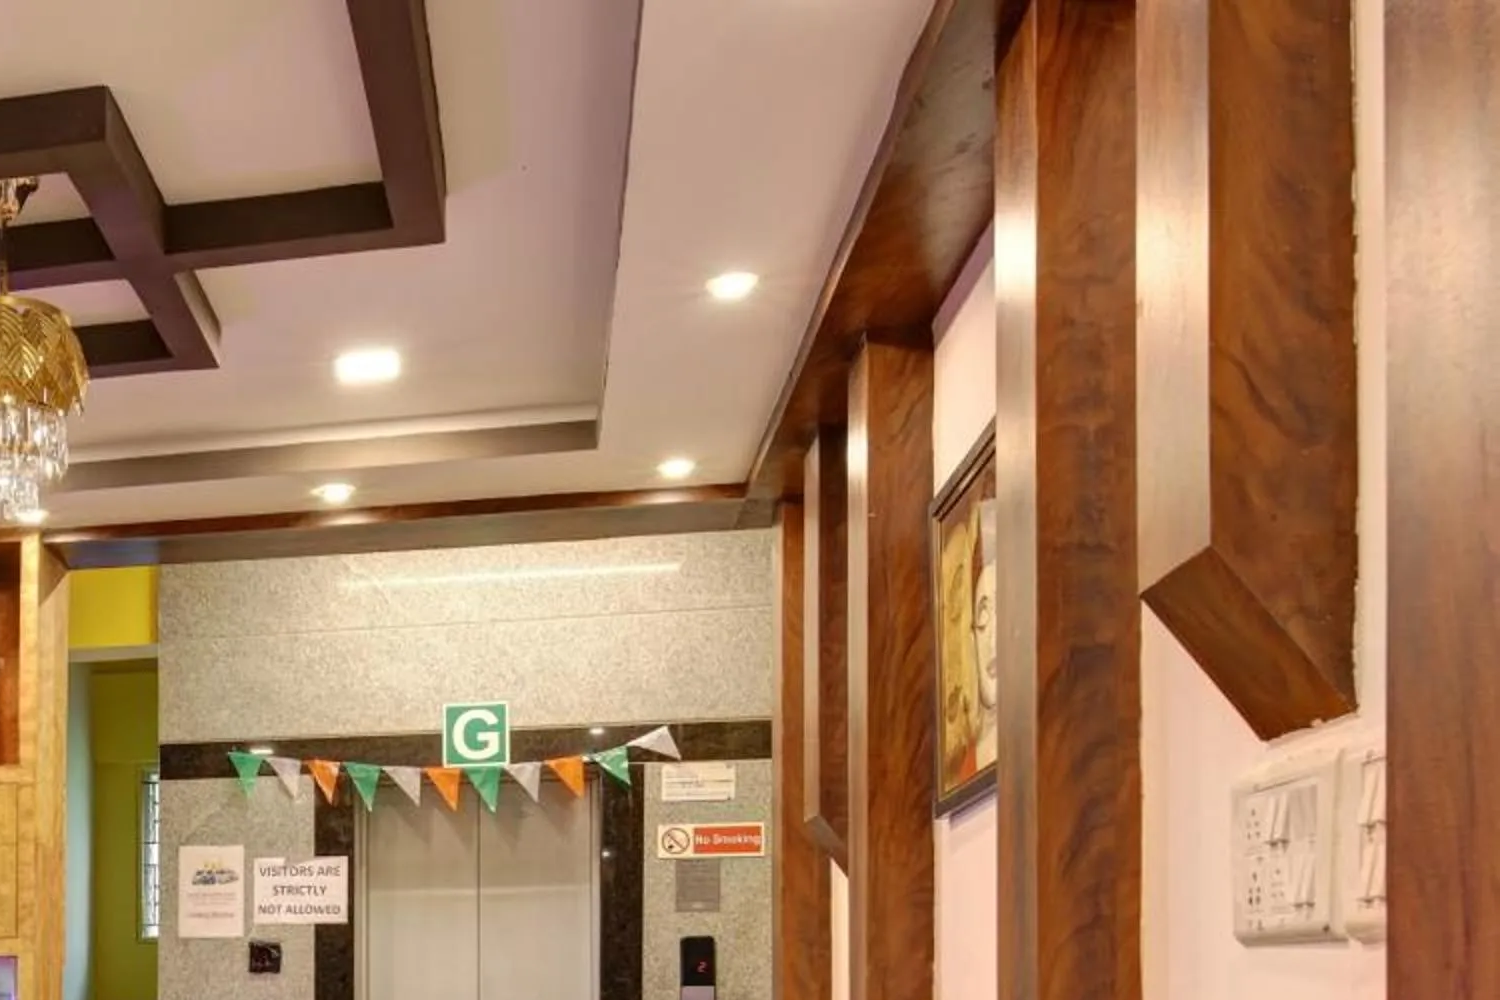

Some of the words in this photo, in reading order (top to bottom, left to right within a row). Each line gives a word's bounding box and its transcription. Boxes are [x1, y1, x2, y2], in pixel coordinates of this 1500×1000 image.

[452, 708, 501, 761] G
[694, 834, 710, 845] No
[711, 832, 762, 847] Smoking
[259, 865, 314, 878] VISITORS
[316, 865, 342, 877] ARE
[272, 885, 328, 897] STRICTLY
[257, 904, 284, 916] NOT
[285, 904, 342, 916] ALLOWED
[697, 960, 708, 973] 2
